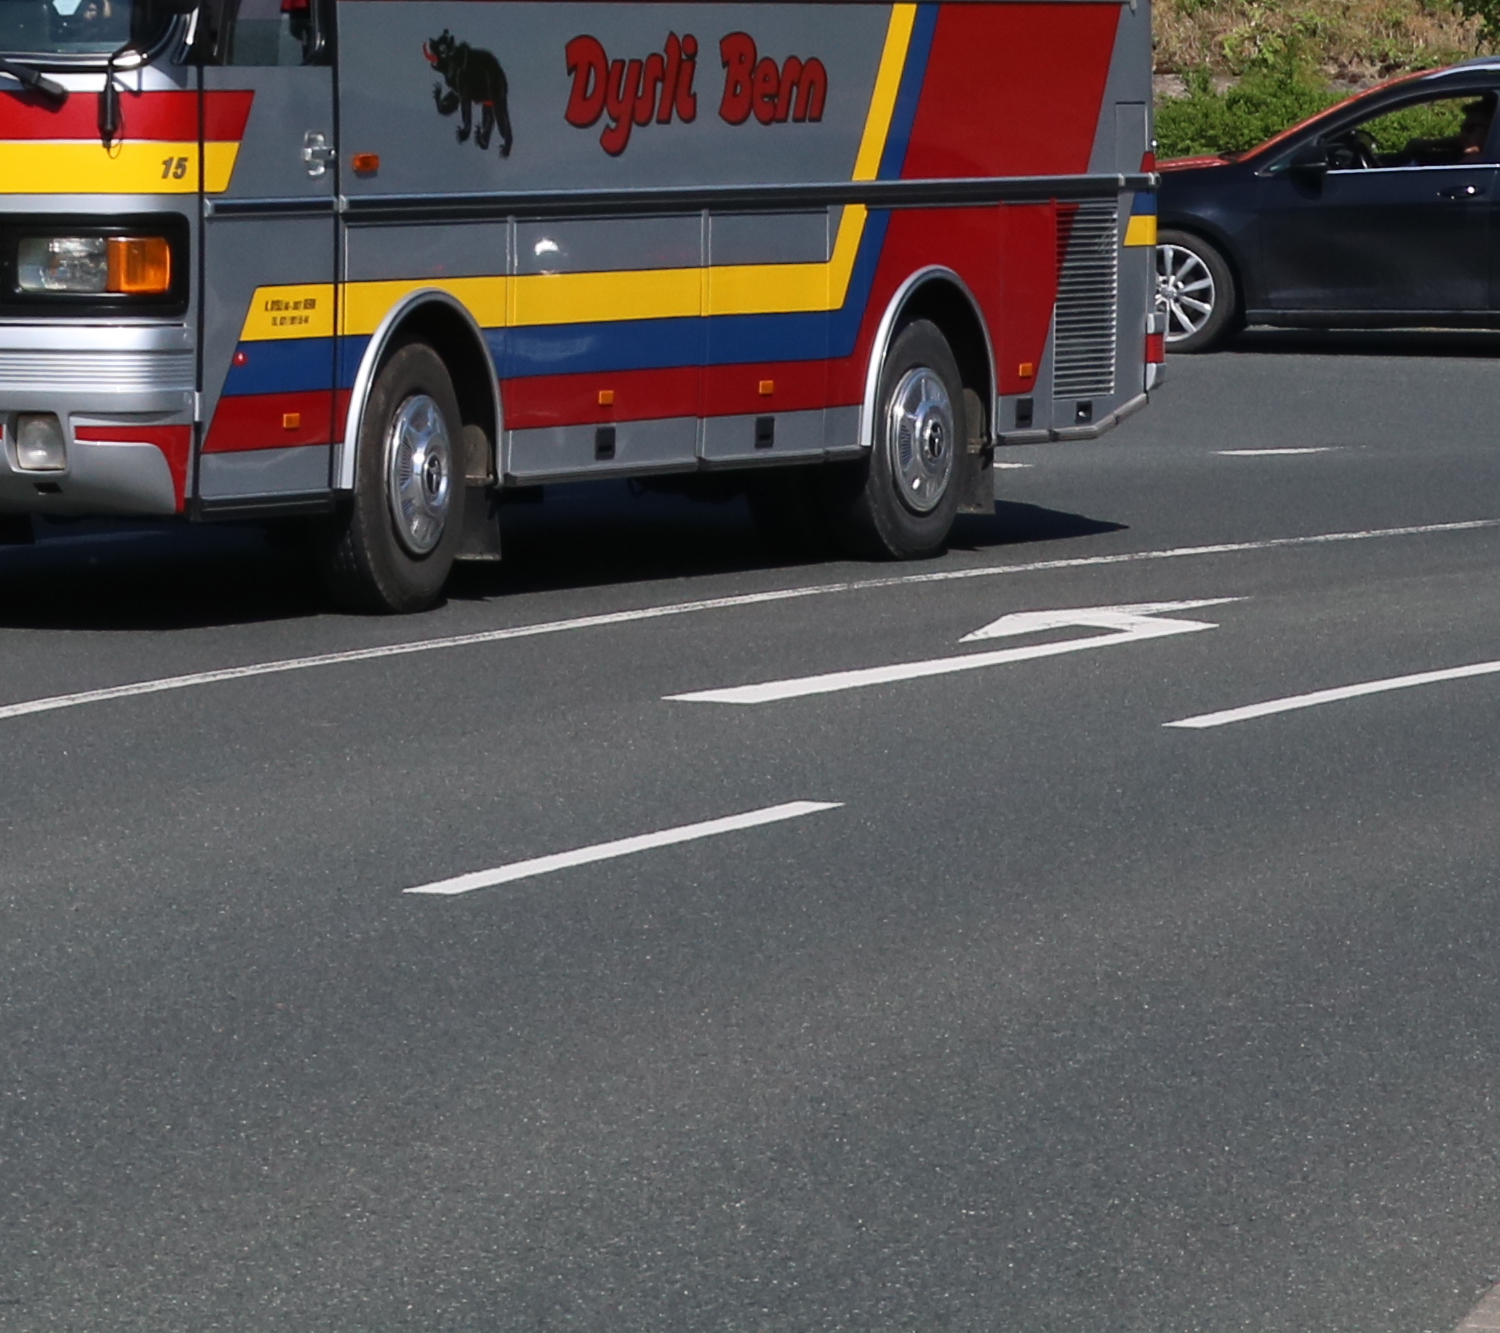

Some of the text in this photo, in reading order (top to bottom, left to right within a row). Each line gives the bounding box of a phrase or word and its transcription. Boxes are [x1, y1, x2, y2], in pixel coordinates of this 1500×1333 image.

[564, 30, 828, 157] Dysli Bern
[161, 156, 189, 180] 15
